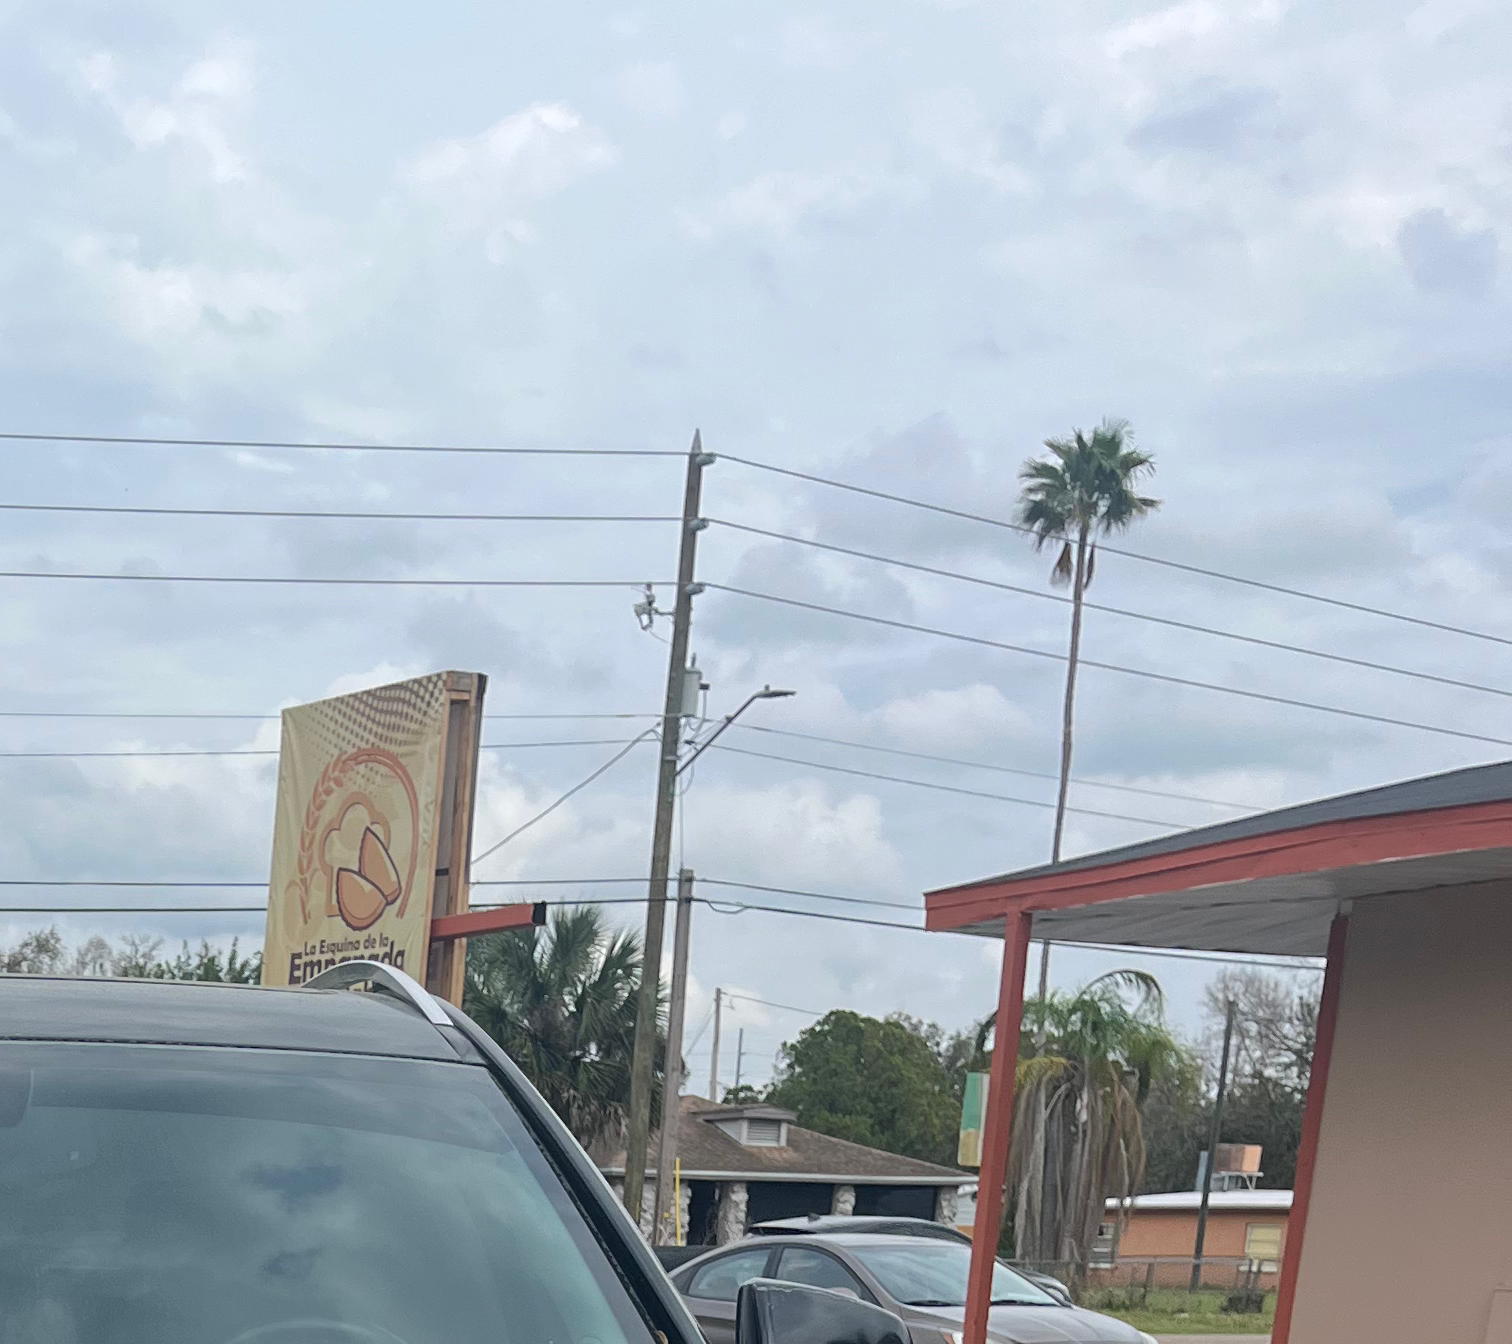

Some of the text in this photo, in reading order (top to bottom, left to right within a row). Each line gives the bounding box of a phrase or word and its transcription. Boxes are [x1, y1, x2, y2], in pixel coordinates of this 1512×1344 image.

[304, 941, 316, 956] La
[363, 933, 376, 949] de
[379, 932, 389, 948] la
